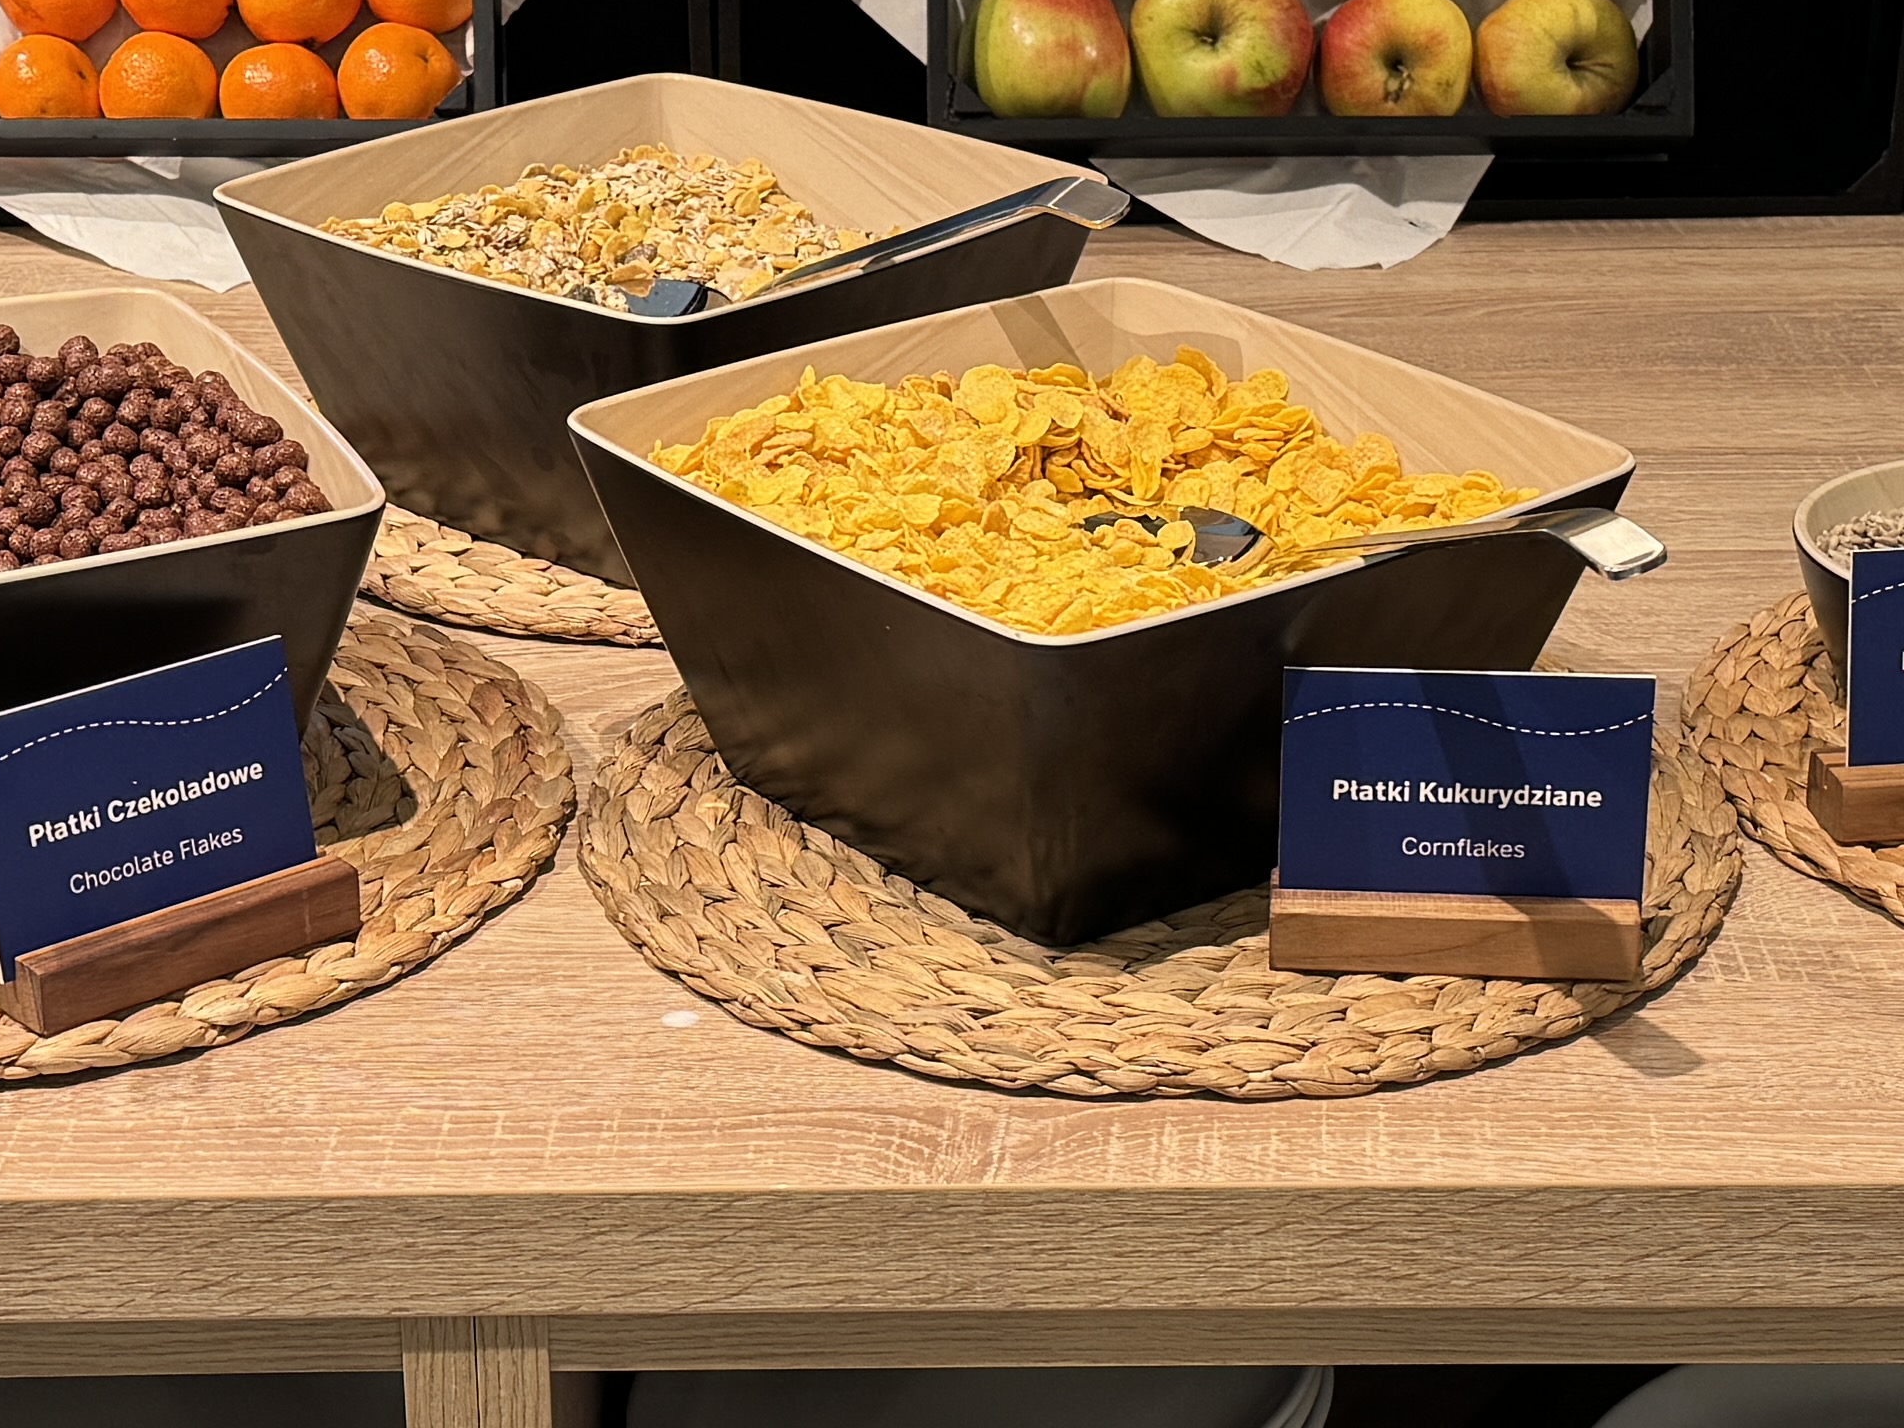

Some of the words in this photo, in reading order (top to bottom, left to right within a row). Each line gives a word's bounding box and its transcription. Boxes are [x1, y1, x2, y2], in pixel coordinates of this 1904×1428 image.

[28, 805, 102, 848] Płatki
[106, 762, 264, 823] Czekoladowe
[1332, 779, 1411, 803] Płatki
[1418, 781, 1603, 809] Kukurydziane
[69, 849, 175, 894] Chocolate
[179, 827, 244, 861] Flakes
[1401, 836, 1526, 859] Cornflakes
